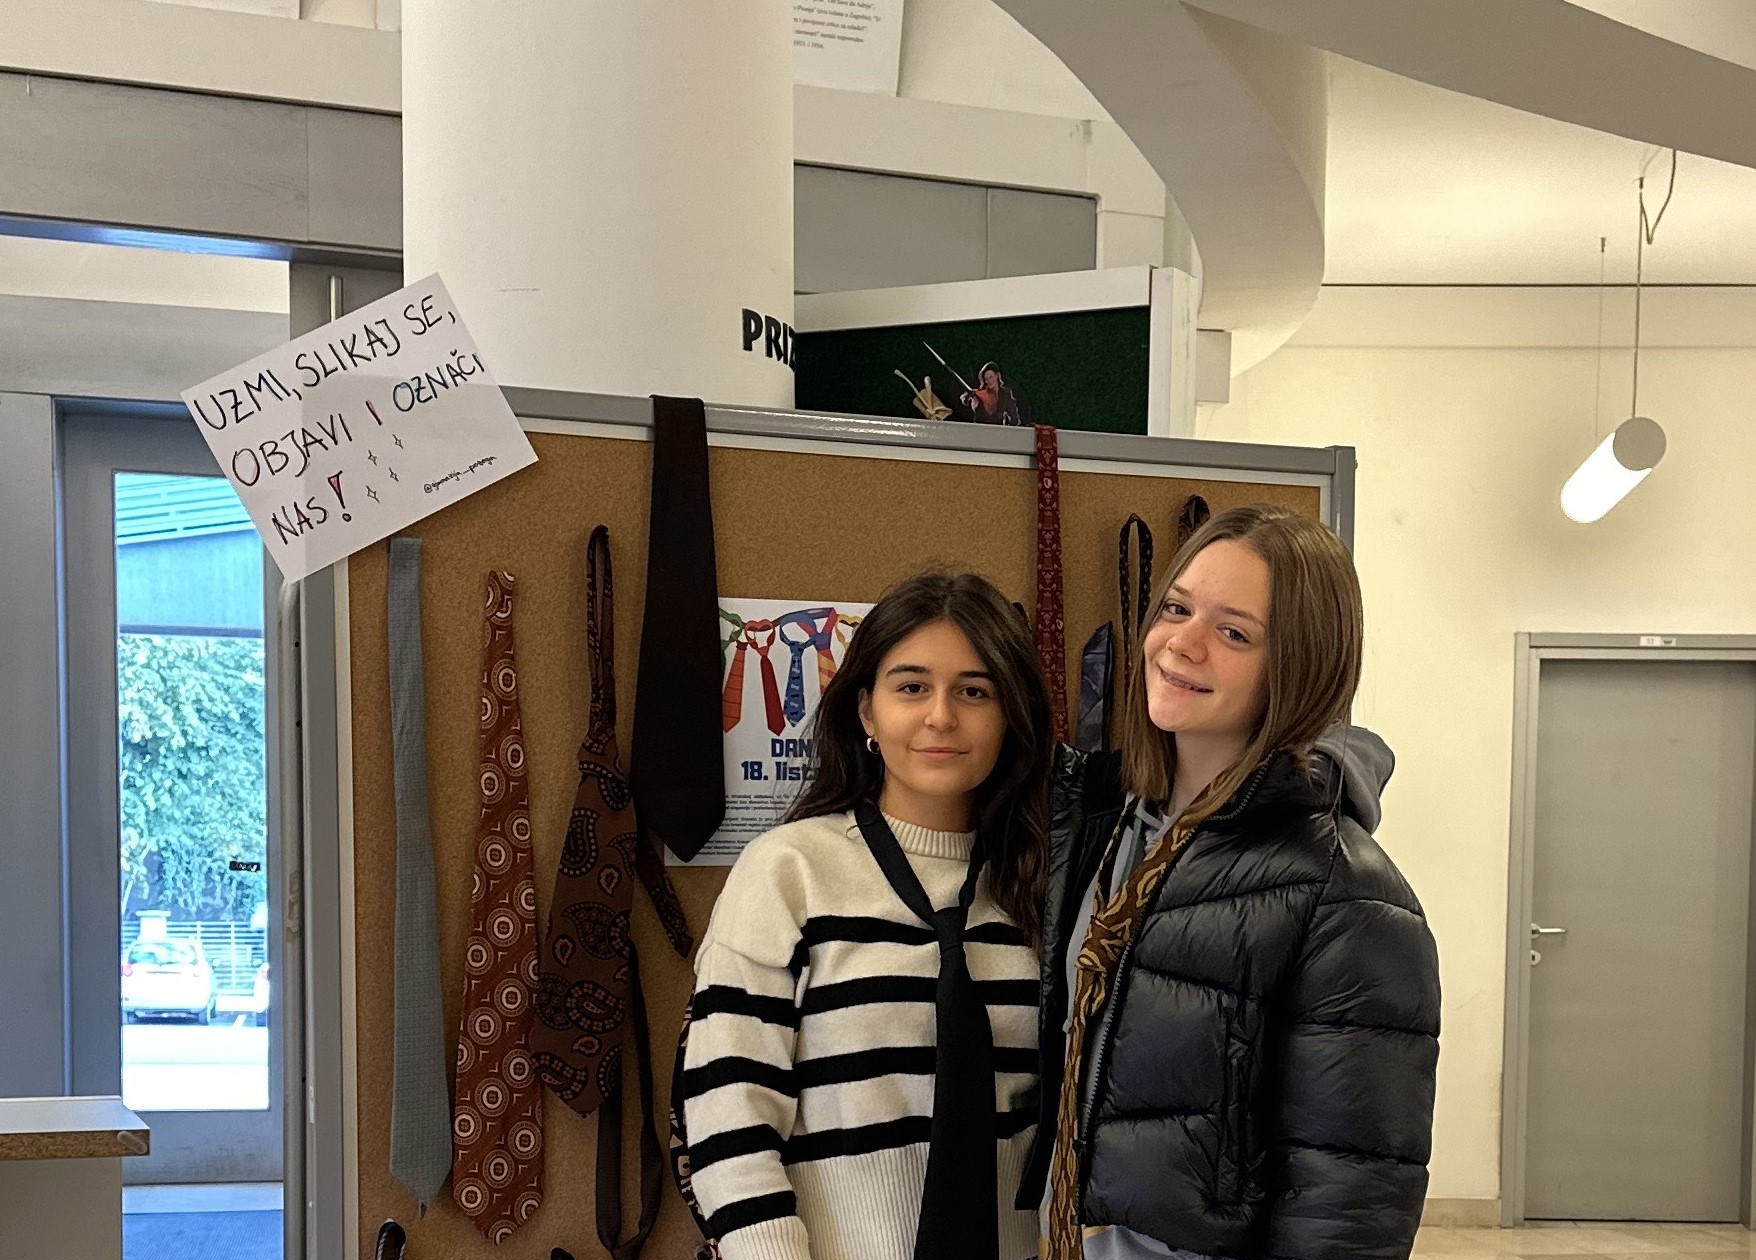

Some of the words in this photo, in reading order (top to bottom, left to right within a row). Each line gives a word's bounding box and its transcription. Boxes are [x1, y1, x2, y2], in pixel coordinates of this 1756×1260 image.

[403, 295, 456, 336] SE,
[231, 413, 353, 486] OBJAVI
[365, 400, 383, 426] I
[392, 349, 486, 412] OZNAČI
[771, 738, 813, 758] DAN
[741, 761, 769, 781] 18.
